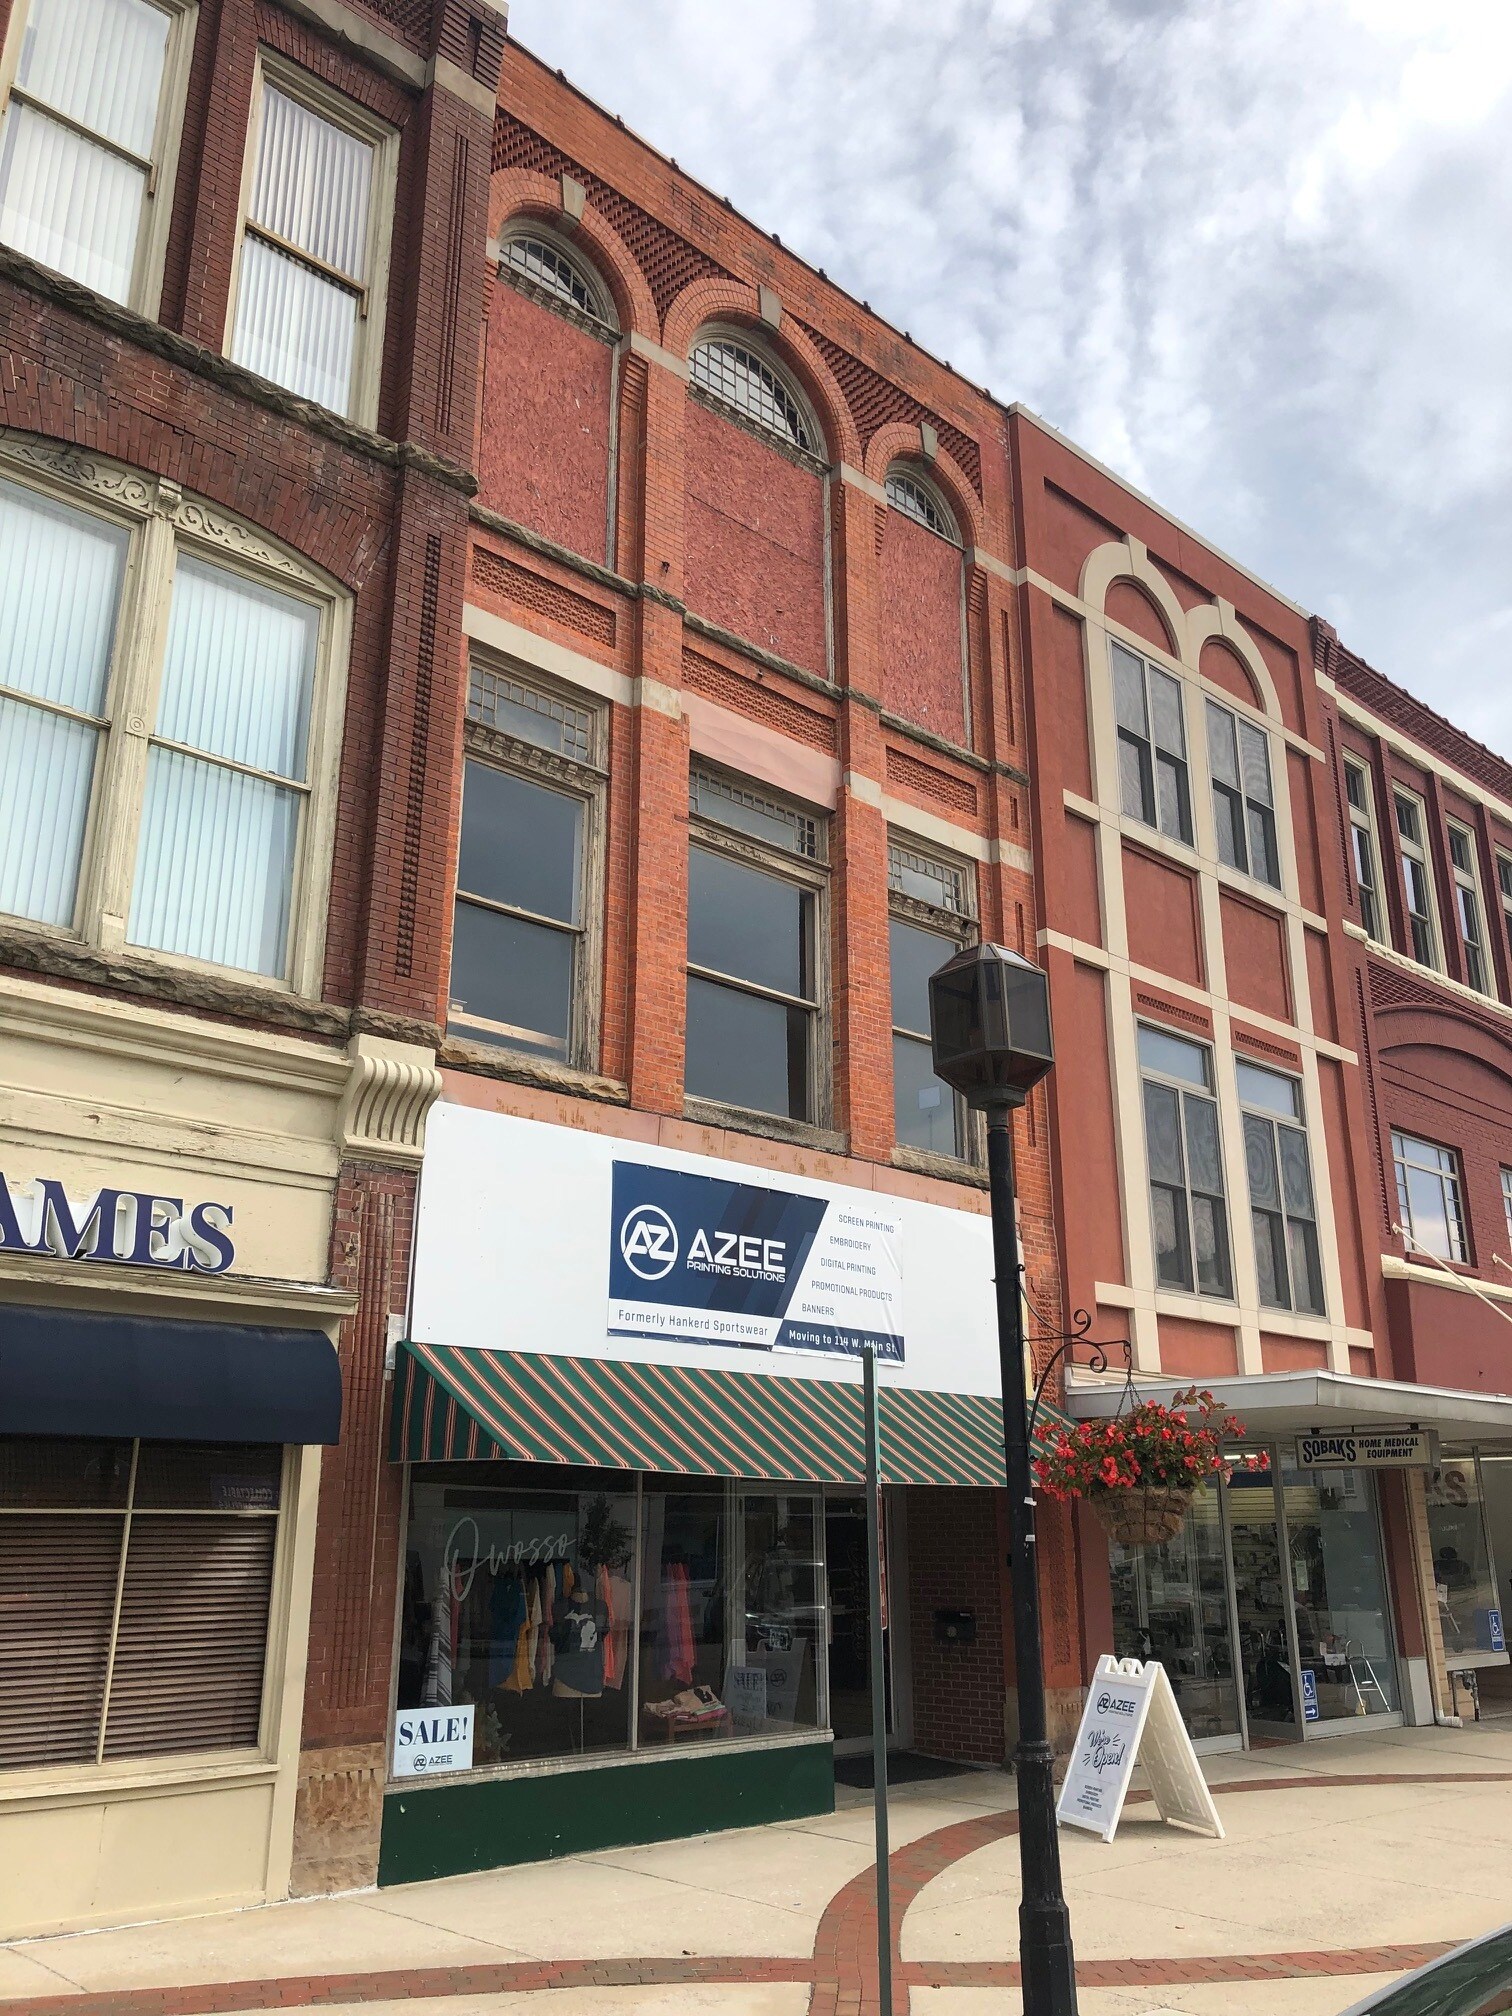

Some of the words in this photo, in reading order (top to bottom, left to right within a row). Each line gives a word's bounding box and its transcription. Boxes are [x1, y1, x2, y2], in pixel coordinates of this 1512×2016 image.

[838, 1214, 864, 1227] SCREEN
[865, 1220, 895, 1233] PRINTING
[687, 1228, 786, 1273] AZEE
[829, 1236, 872, 1251] EMBROIDERY
[686, 1261, 731, 1275] PRINTING
[732, 1268, 786, 1283] SOLUTIONS
[820, 1257, 846, 1271] DIGITAL
[846, 1262, 876, 1275] PRINTING
[811, 1280, 858, 1296] PROMOTIONAL
[859, 1288, 893, 1302] PRODUCTS
[801, 1303, 835, 1316] BANNERS
[618, 1309, 666, 1327] Formerly
[669, 1315, 710, 1330] Hankerd
[713, 1320, 768, 1336] Sportswear
[788, 1329, 820, 1345] Moving
[822, 1333, 832, 1344] to
[834, 1335, 849, 1346] 114
[851, 1337, 861, 1348] W.
[1302, 1438, 1357, 1463] SOBAKS
[1358, 1439, 1382, 1448] HOME
[1383, 1437, 1419, 1447] MEDICAL
[1366, 1448, 1414, 1459] EQUIPMENT
[444, 1517, 578, 1602] Owosso
[1109, 1699, 1136, 1713] AZEE
[398, 1716, 468, 1746] SALE!
[428, 1754, 453, 1765] AZEE
